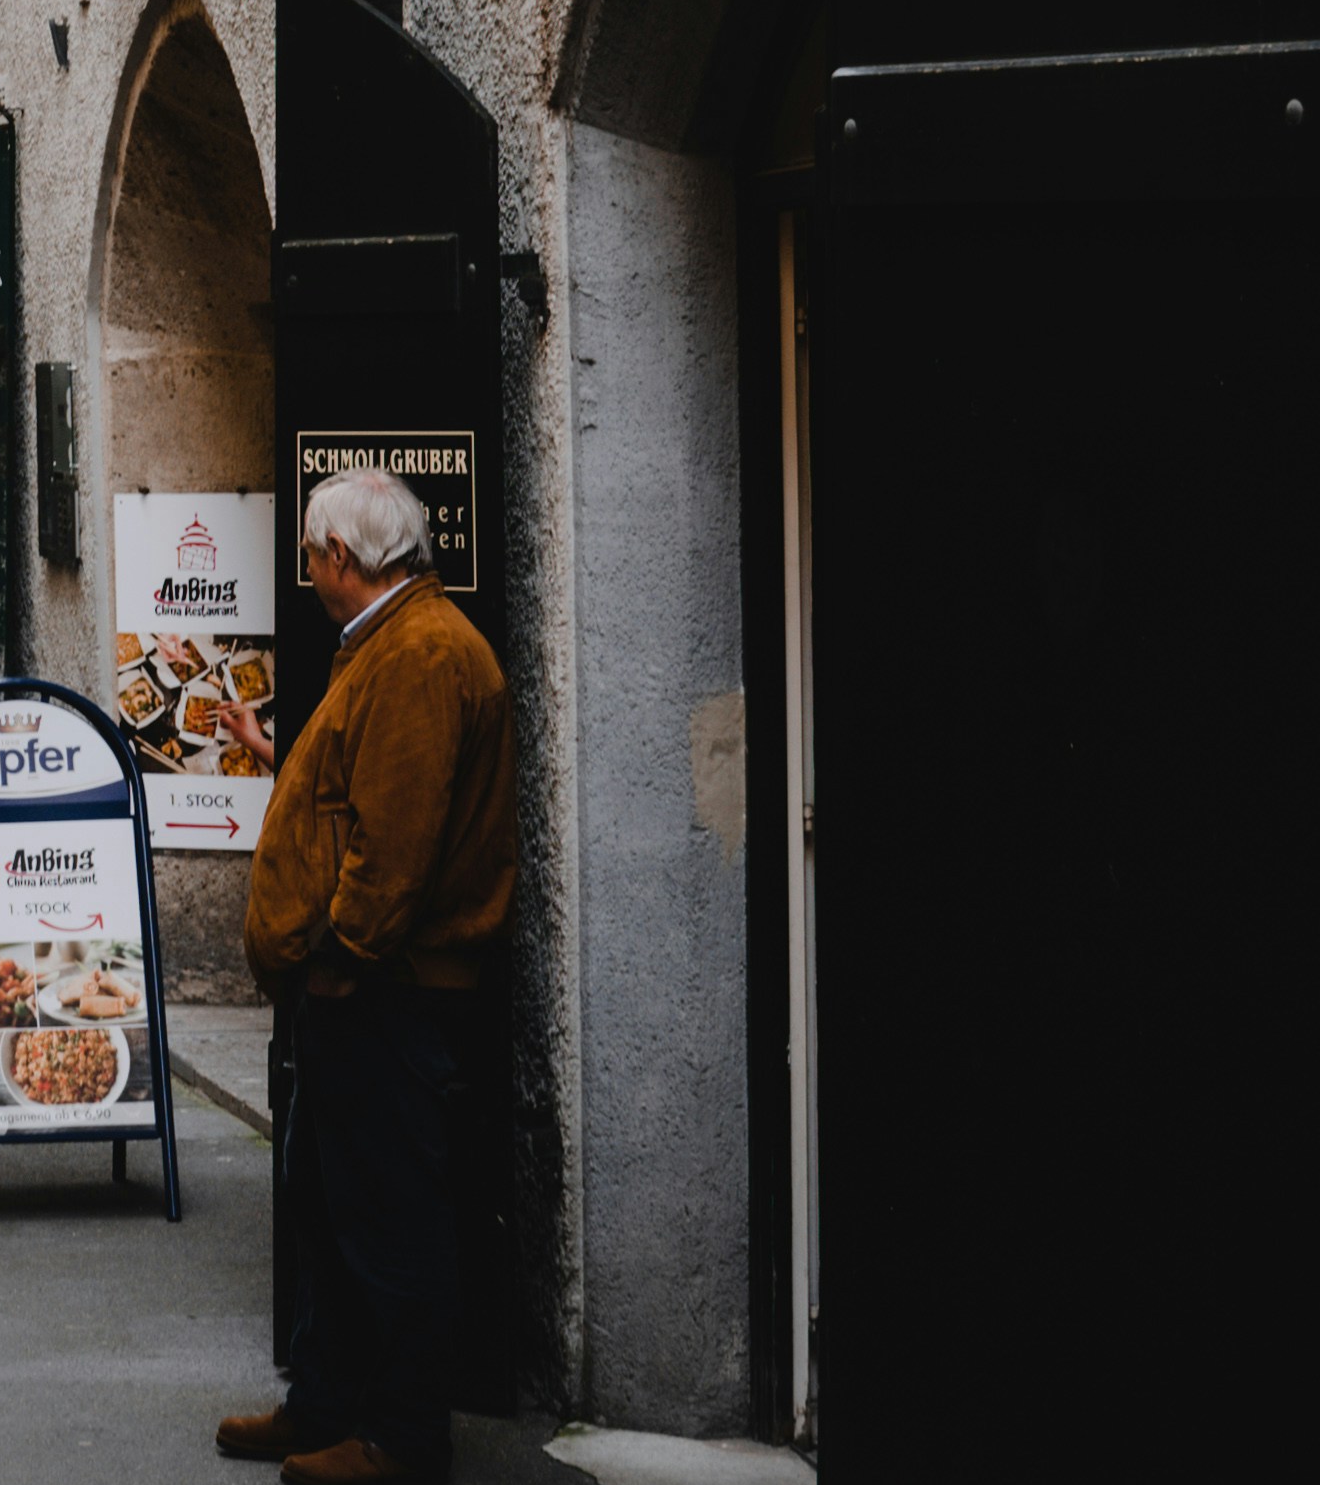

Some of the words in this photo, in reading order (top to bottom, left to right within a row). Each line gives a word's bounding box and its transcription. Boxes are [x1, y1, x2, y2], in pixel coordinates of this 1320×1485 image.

[303, 448, 468, 475] SCHMOLLGRUBER
[160, 577, 238, 602] AnBing
[155, 605, 182, 617] China
[185, 604, 239, 617] Restaurant
[170, 793, 181, 807] 1.
[186, 793, 234, 808] STOCK
[12, 847, 95, 873] AnBing
[7, 876, 36, 888] China
[39, 874, 97, 887] Restaurant
[25, 902, 72, 915] STOCK
